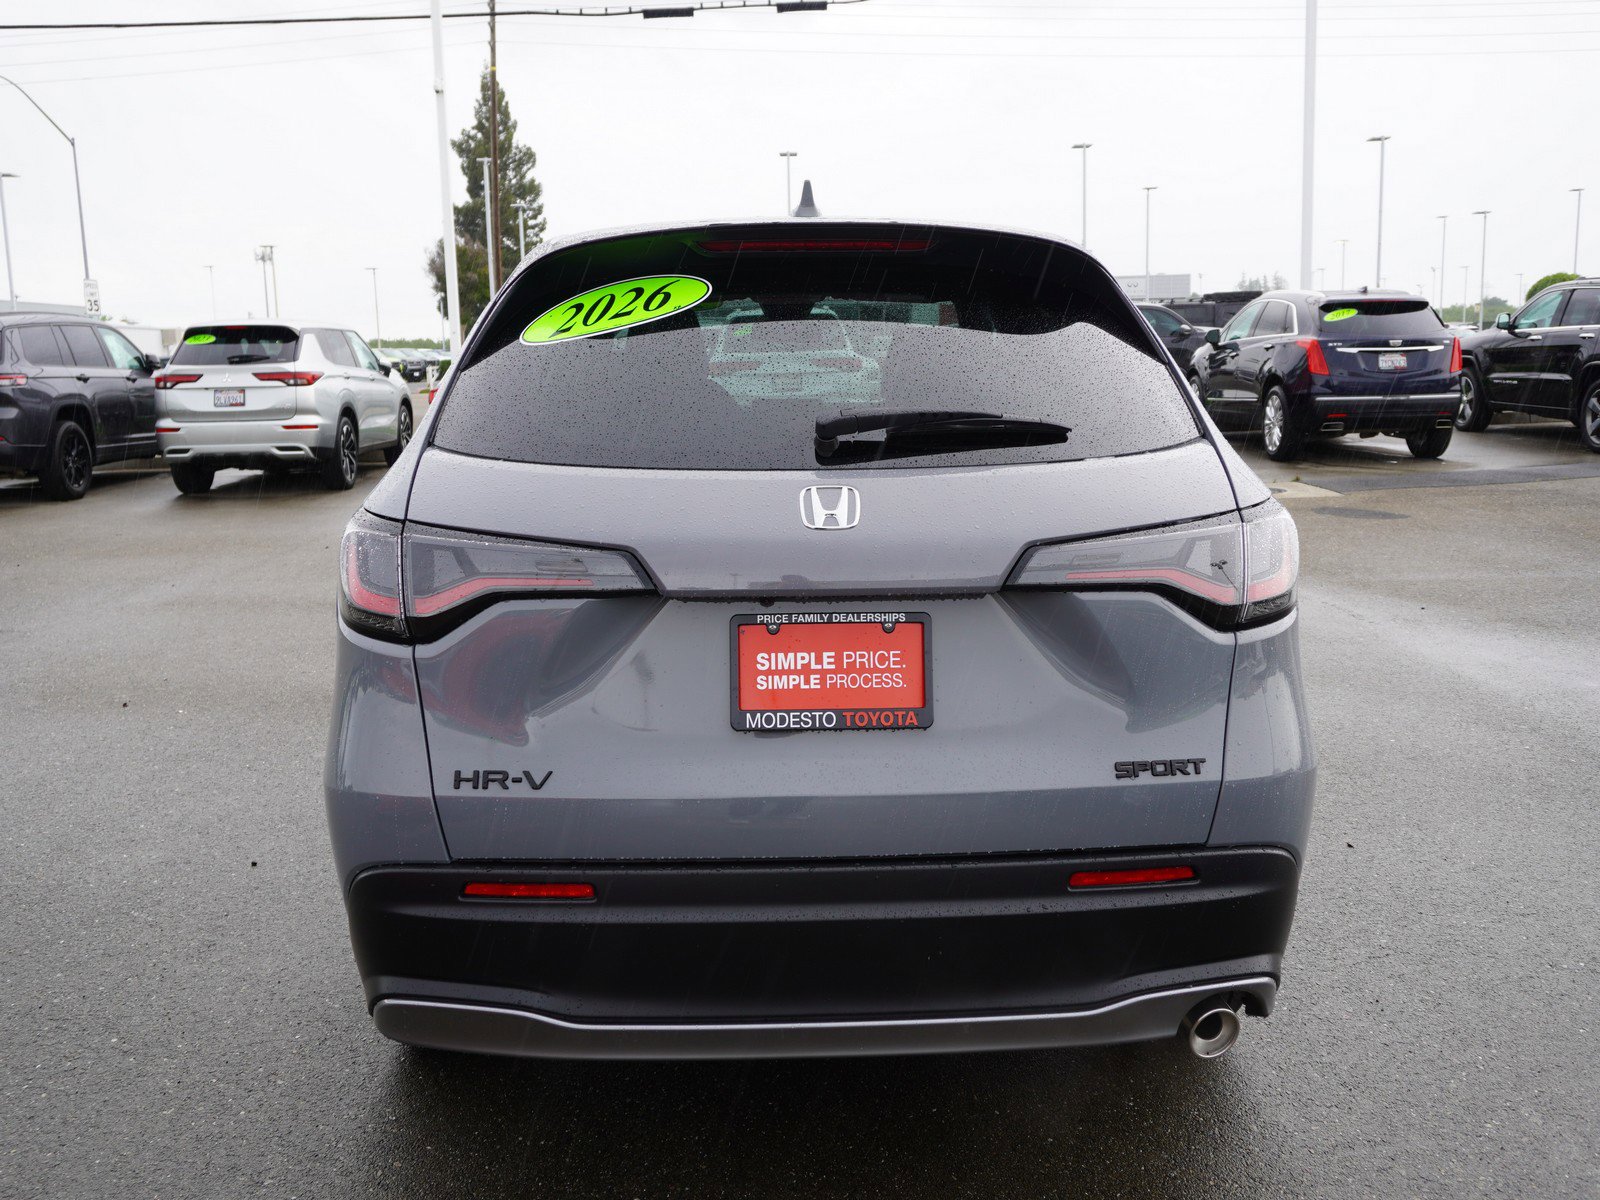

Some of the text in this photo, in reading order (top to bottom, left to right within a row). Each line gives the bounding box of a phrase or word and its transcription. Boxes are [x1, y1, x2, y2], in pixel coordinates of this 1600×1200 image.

[87, 299, 100, 312] 35
[548, 279, 681, 339] 2026
[757, 612, 906, 624] PRICE FAMILY DEALERSHIPS
[756, 650, 907, 671] SIMPLE PRICE.
[756, 673, 907, 690] SIMPLE PROCESS.
[746, 710, 919, 728] MODESTO TOYOTA
[1114, 758, 1207, 779] SPORT
[453, 770, 554, 790] HR-V
